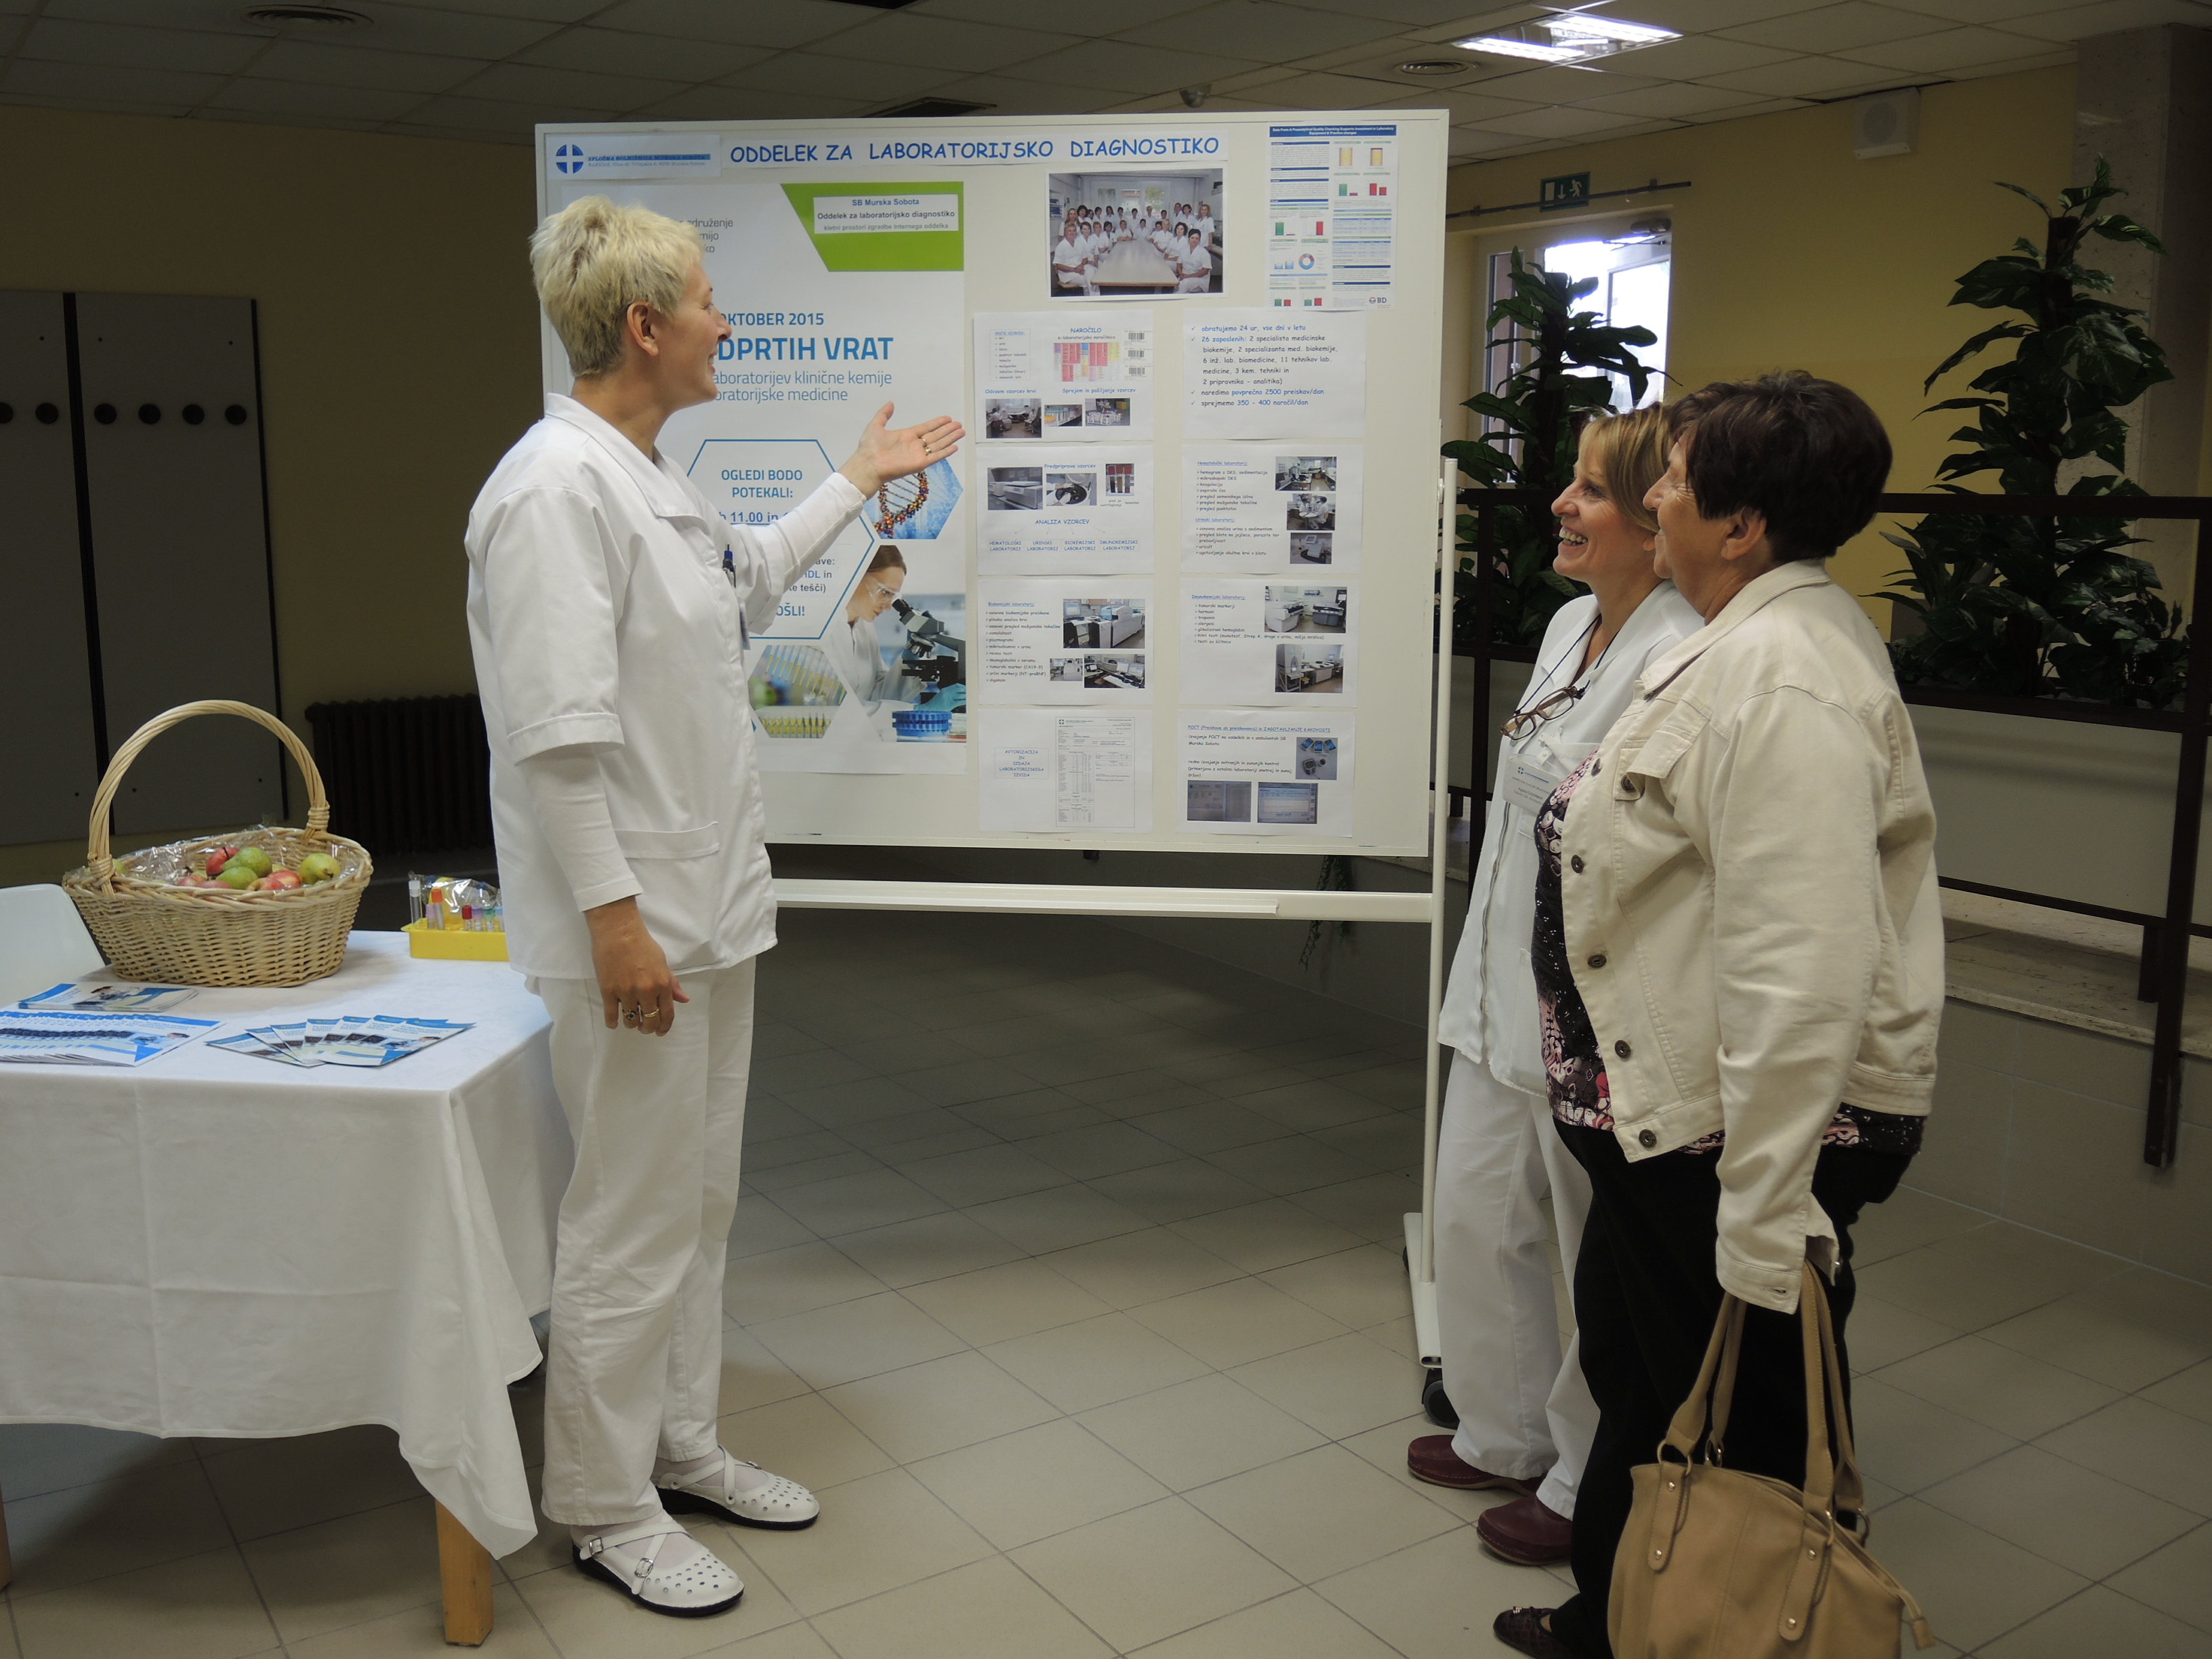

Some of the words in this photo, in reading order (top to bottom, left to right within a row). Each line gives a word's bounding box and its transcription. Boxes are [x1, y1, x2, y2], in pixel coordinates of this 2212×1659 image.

[731, 144, 818, 163] ODDELEK
[826, 144, 853, 161] ZA
[869, 140, 1053, 160] LABORATORIJSKO
[1071, 138, 1219, 157] DIAGNOSTIKO
[700, 231, 719, 242] mijo
[788, 313, 824, 325] 2015
[718, 337, 815, 361] DPRTIH
[823, 337, 894, 361] VRAT
[713, 371, 791, 388] aboratorijev
[794, 370, 844, 384] klinične
[848, 371, 892, 388] kemije
[716, 387, 784, 404] oratorijske
[788, 387, 848, 401] medicine
[721, 470, 764, 480] OGLEDI
[769, 470, 803, 480] BODO
[732, 487, 793, 498] POTEKALI:
[731, 512, 763, 523] 11.00
[823, 570, 832, 578] in
[800, 583, 826, 594] tešči)
